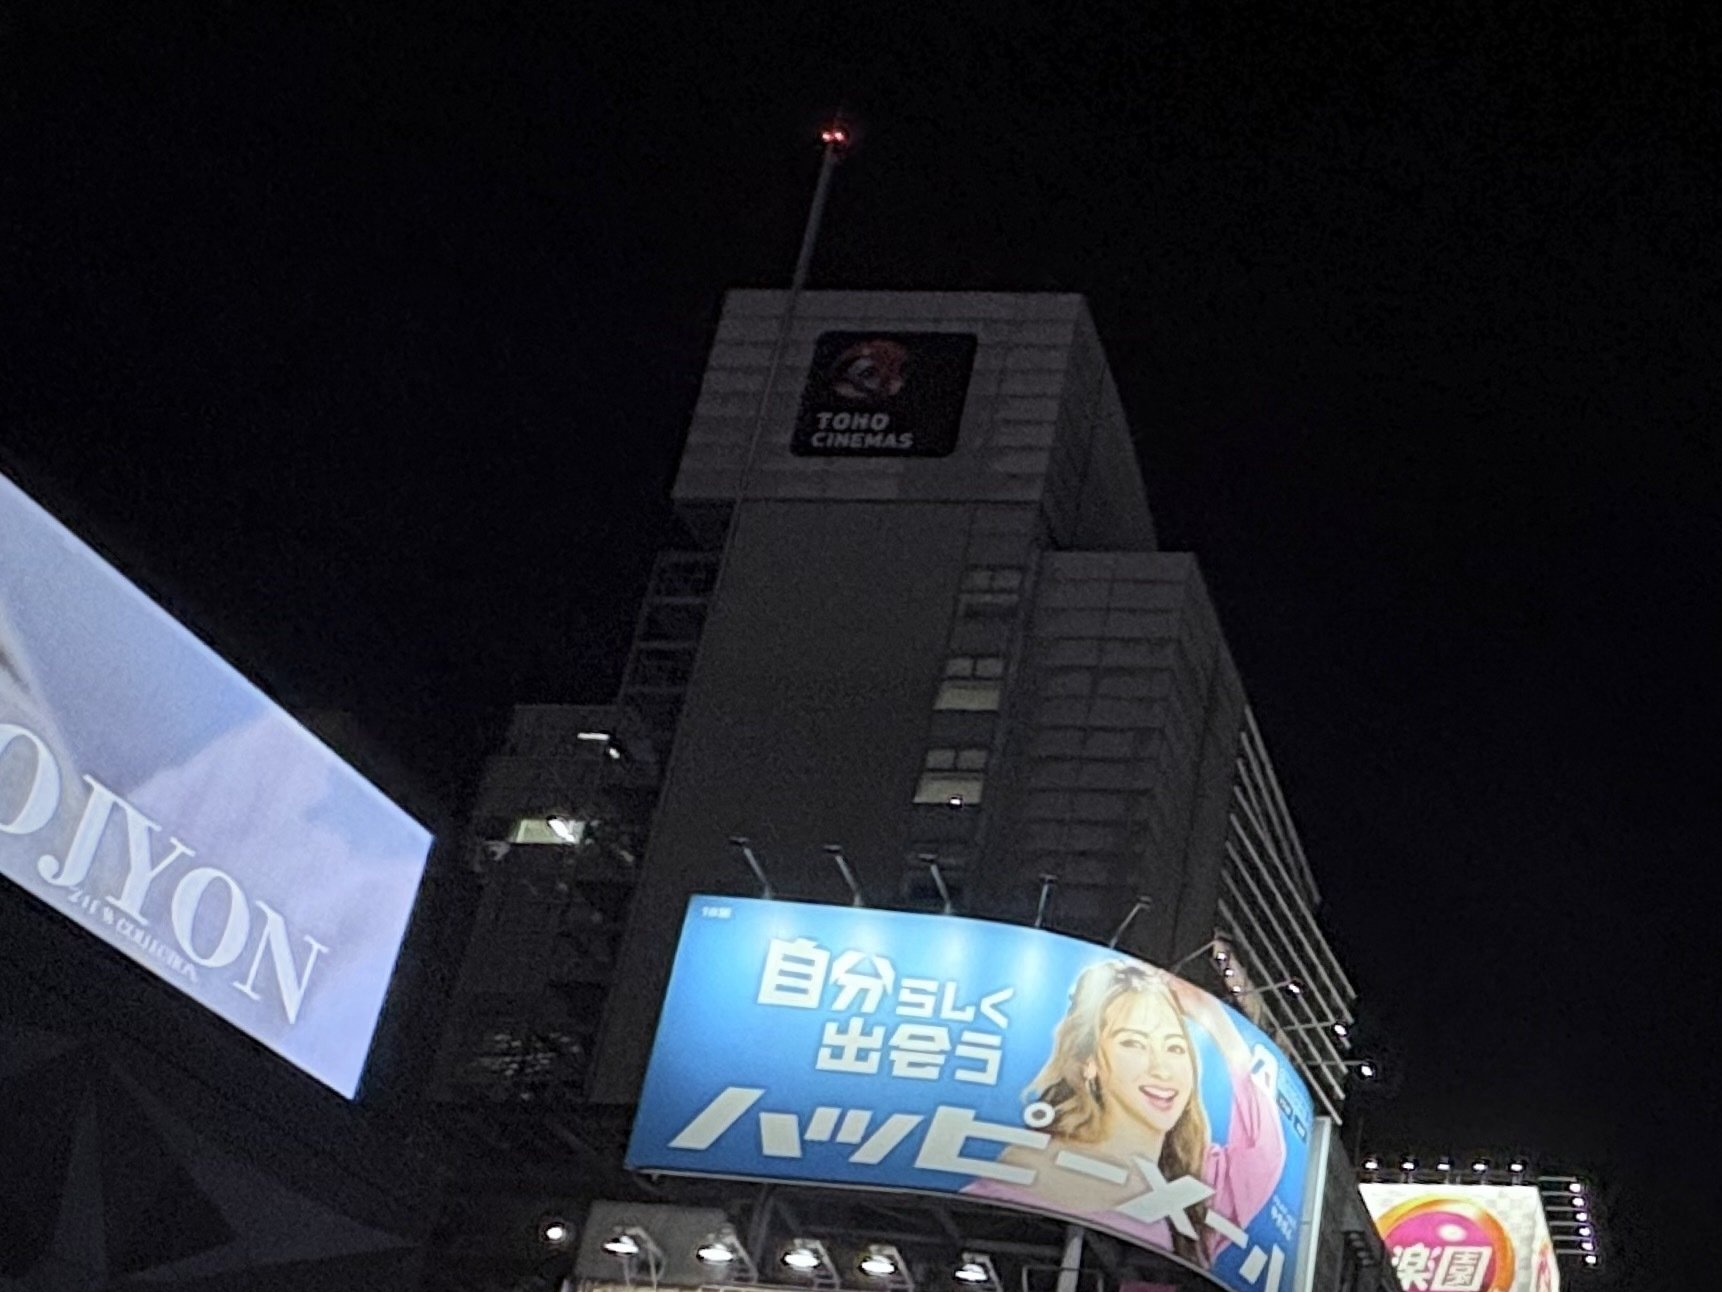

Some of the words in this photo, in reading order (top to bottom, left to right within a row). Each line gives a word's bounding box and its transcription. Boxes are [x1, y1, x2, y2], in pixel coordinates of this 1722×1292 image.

[811, 431, 914, 450] CINEMAS
[816, 411, 890, 431] TOHO
[757, 937, 1015, 1029] 自分らしく
[815, 1016, 1003, 1084] 出会う
[1391, 1243, 1493, 1292] 楽園
